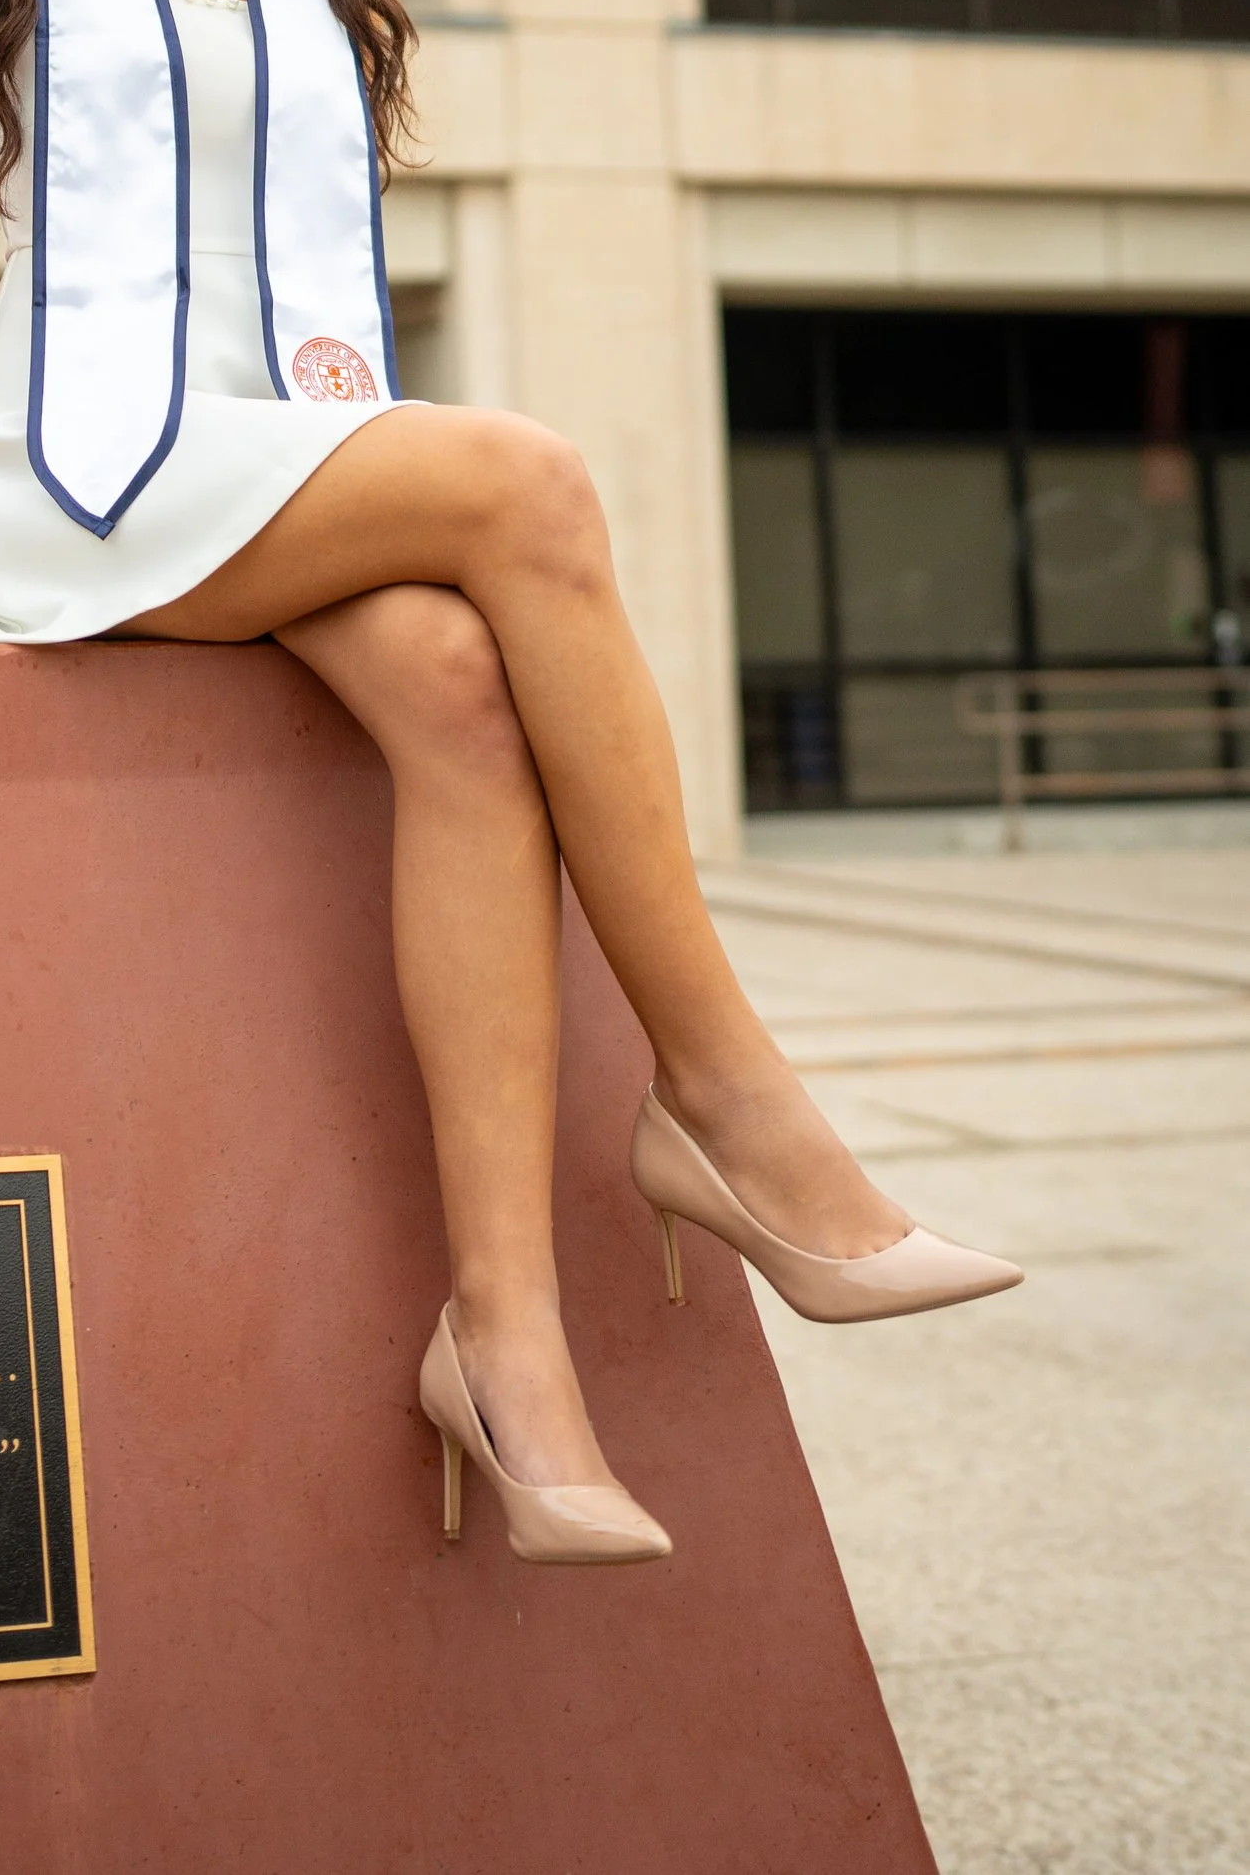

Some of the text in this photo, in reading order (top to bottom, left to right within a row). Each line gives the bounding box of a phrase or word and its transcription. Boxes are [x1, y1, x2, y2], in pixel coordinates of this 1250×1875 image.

[300, 343, 342, 365] UNIVERSITY
[343, 352, 355, 361] OF
[297, 365, 307, 381] THE
[355, 361, 372, 391] TEXAS
